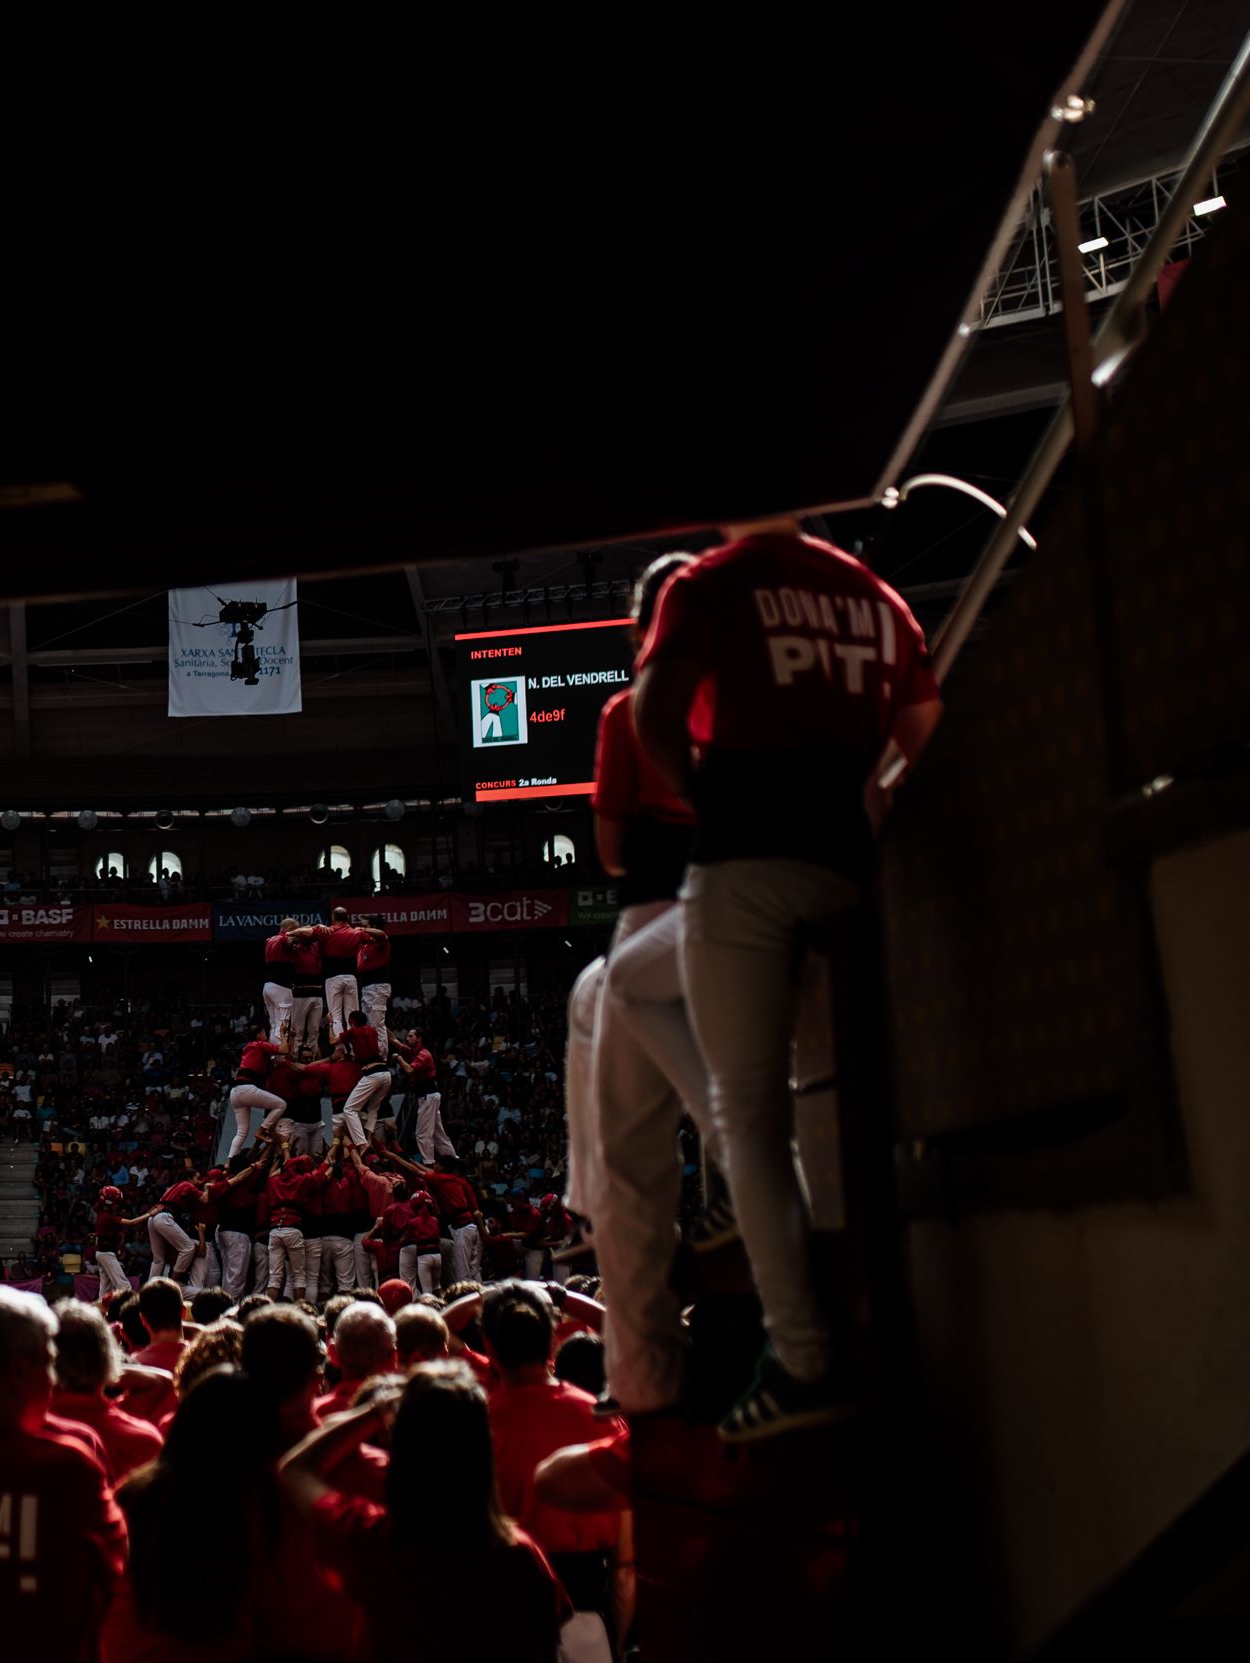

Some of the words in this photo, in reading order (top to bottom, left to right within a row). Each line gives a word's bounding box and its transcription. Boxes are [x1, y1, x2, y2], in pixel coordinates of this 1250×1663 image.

[753, 586, 876, 638] DONA'M
[181, 648, 216, 658] XARXA
[255, 645, 286, 656] TECLA
[470, 646, 523, 660] INTENTEN
[259, 656, 293, 665] Docent
[193, 670, 230, 678] Tarragona
[259, 666, 281, 677] 1171
[527, 677, 540, 690] N.
[541, 675, 566, 689] DEL
[565, 669, 630, 687] VENDRELL
[529, 708, 566, 723] 4de9f
[475, 779, 517, 790] CONCURS
[518, 778, 530, 787] 2a
[530, 776, 558, 786] Ronda
[21, 908, 74, 925] BASF
[409, 908, 448, 921] DAMM
[468, 896, 532, 923] 3cat
[113, 918, 170, 930] ESTRELLA
[172, 917, 210, 930] DAMM
[8, 929, 34, 938] create
[34, 928, 75, 939] chemistry
